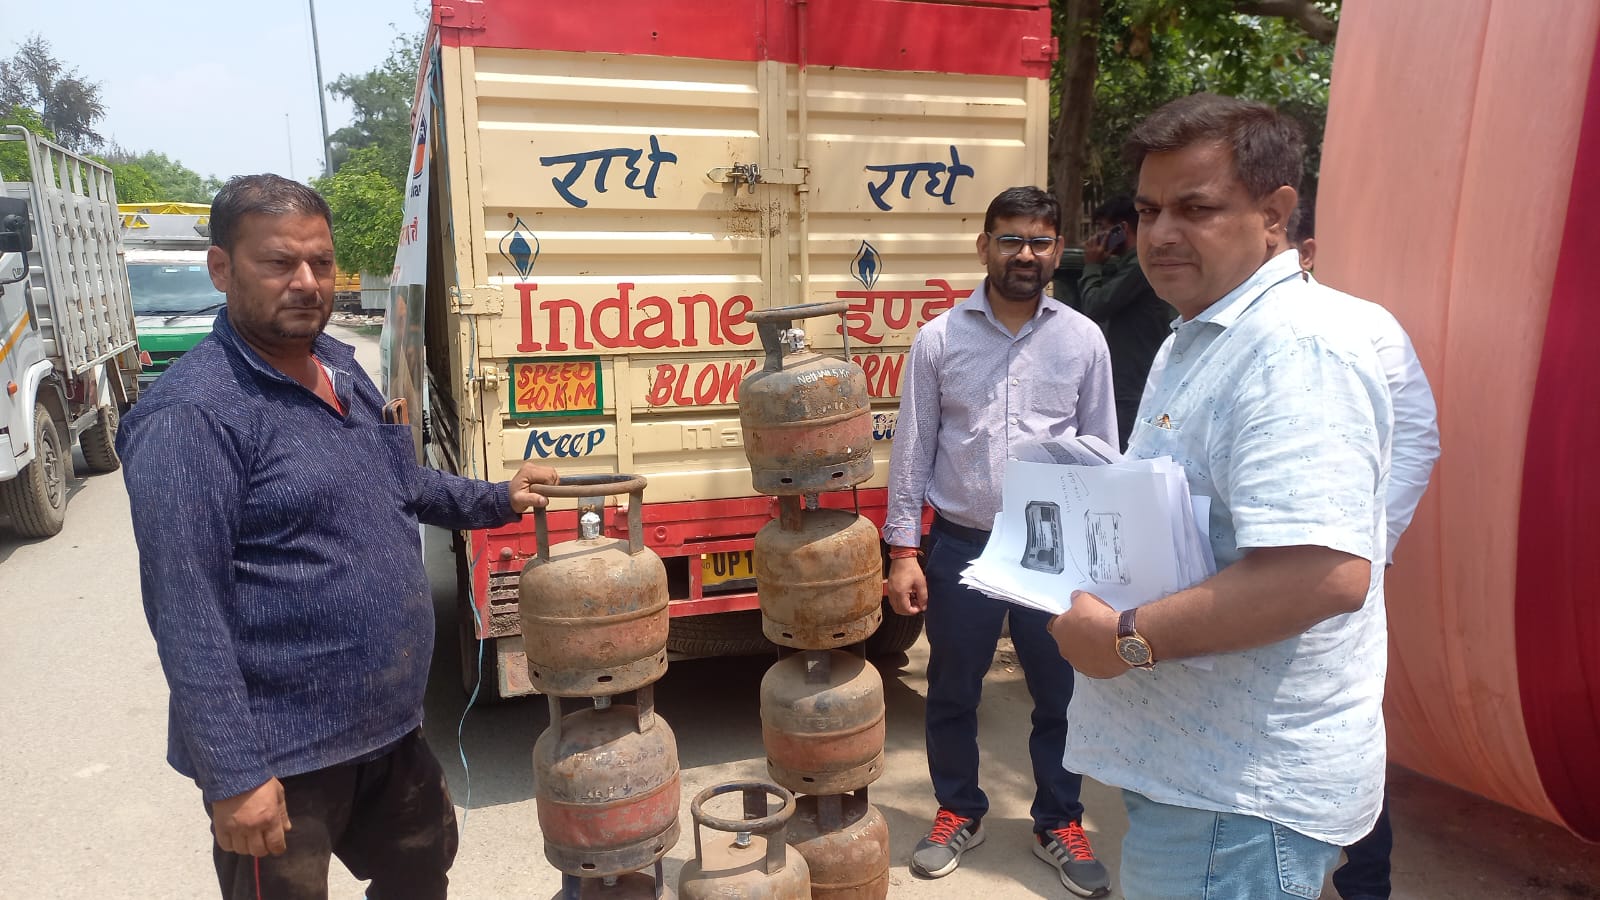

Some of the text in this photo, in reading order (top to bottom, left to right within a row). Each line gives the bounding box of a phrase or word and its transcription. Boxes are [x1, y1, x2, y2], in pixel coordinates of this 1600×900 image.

[539, 134, 677, 208] राधे
[865, 145, 974, 211] राधे
[514, 283, 754, 352] Indane
[517, 362, 594, 389] SPEED
[646, 354, 904, 406] BLOW RN
